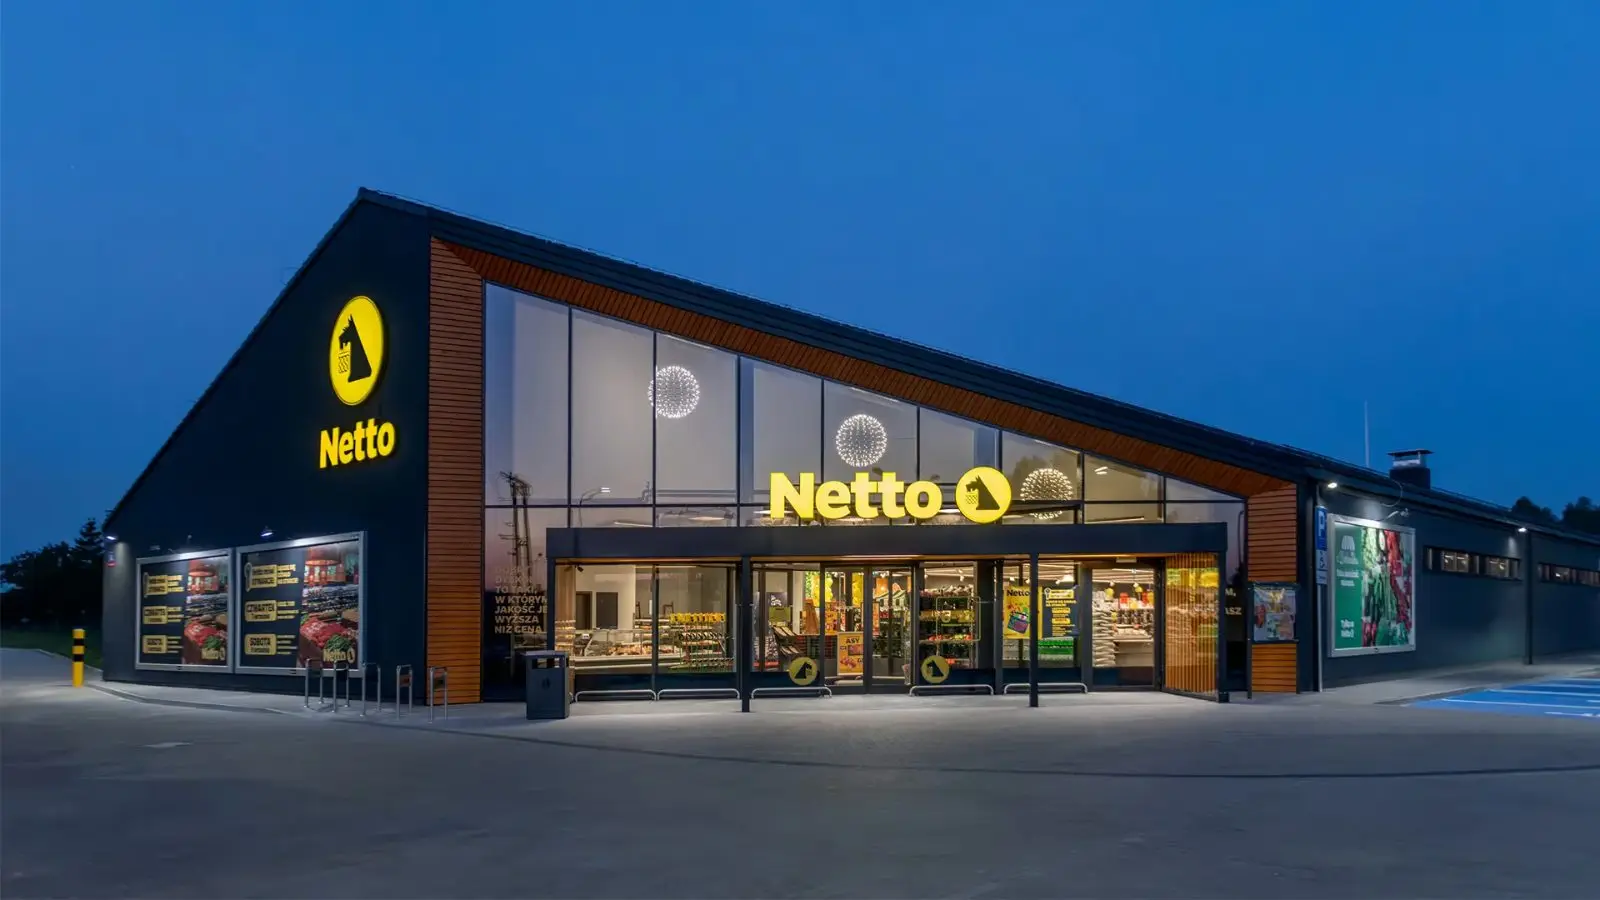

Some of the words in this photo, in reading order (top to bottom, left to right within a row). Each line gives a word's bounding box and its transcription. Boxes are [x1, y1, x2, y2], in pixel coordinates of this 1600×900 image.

[320, 418, 395, 469] Netto
[770, 472, 943, 519] Netto
[1318, 510, 1325, 537] P
[1006, 589, 1031, 597] Netto
[494, 595, 506, 604] W
[494, 603, 536, 614] JAKOŚĆ
[536, 605, 548, 614] JE
[494, 613, 540, 624] WYŻSZA
[494, 623, 513, 634] NIŻ
[514, 625, 543, 634] CENA
